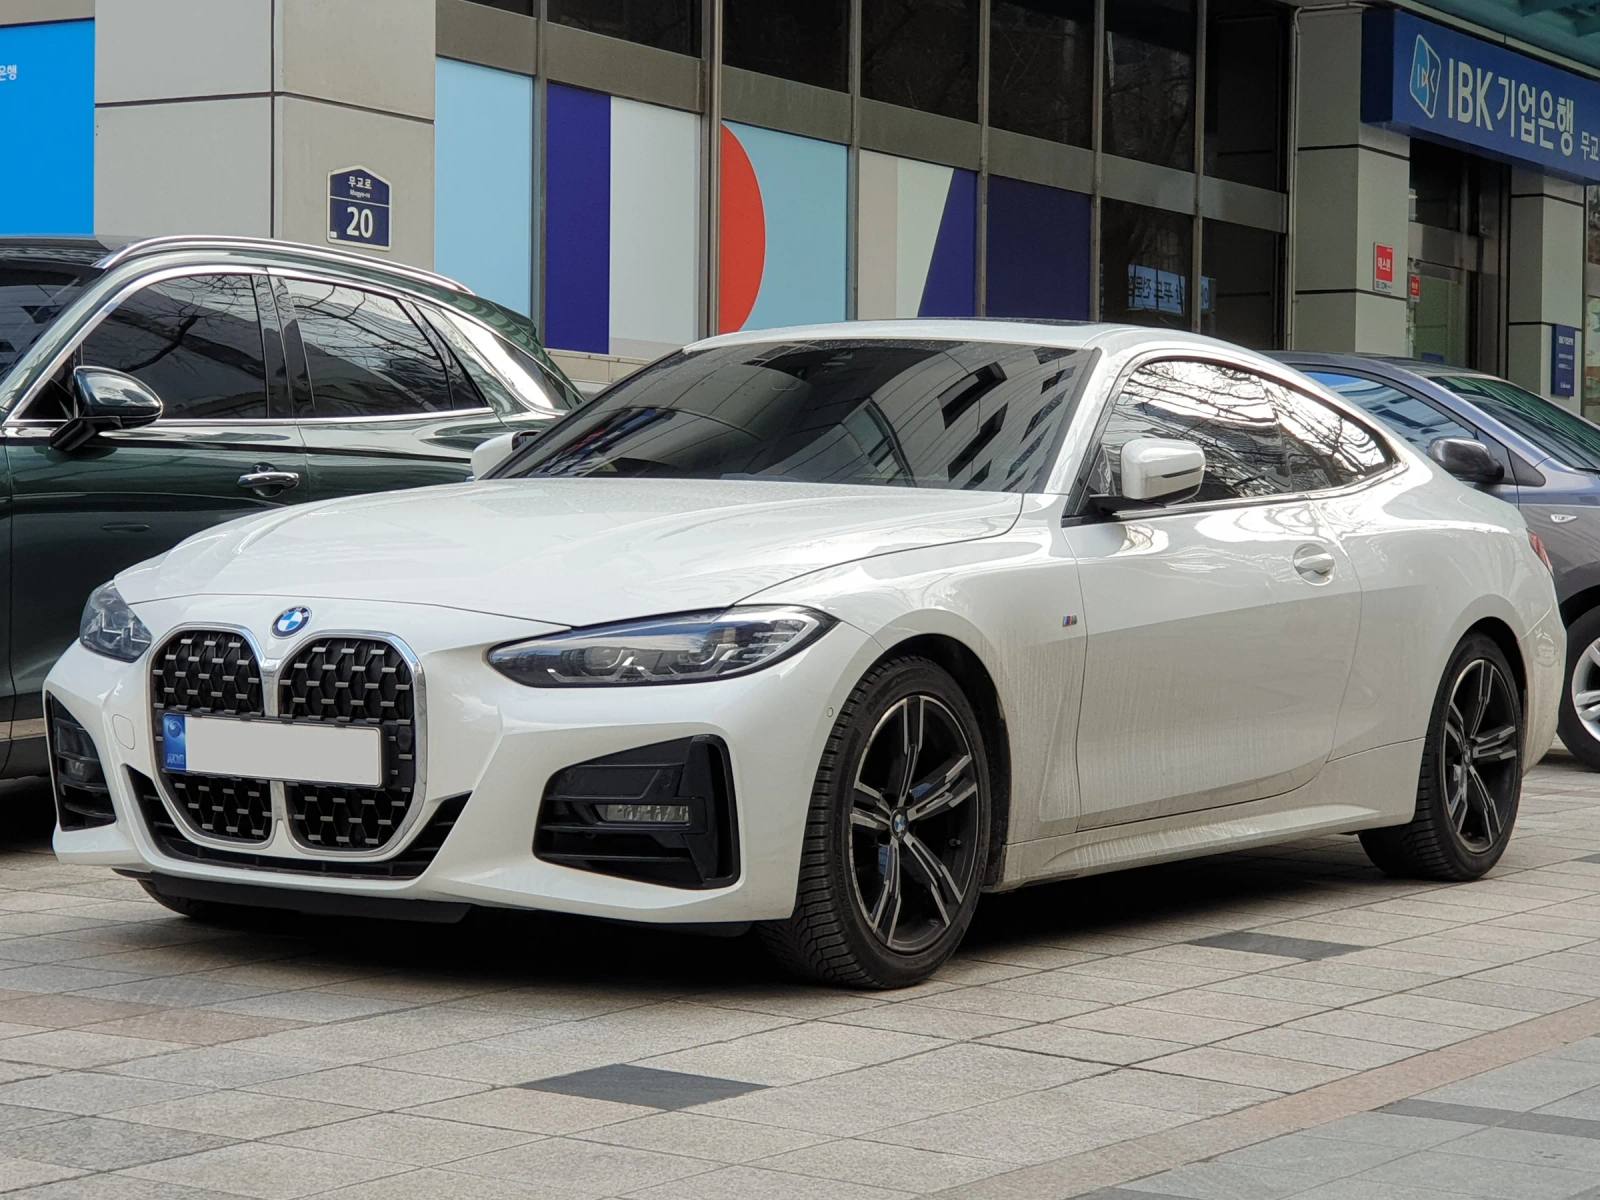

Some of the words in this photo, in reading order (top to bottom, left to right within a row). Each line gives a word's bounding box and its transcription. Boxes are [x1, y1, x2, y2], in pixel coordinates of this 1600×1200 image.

[1447, 58, 1574, 157] IBK기업은행
[347, 176, 373, 189] 무교로
[346, 206, 373, 238] 20
